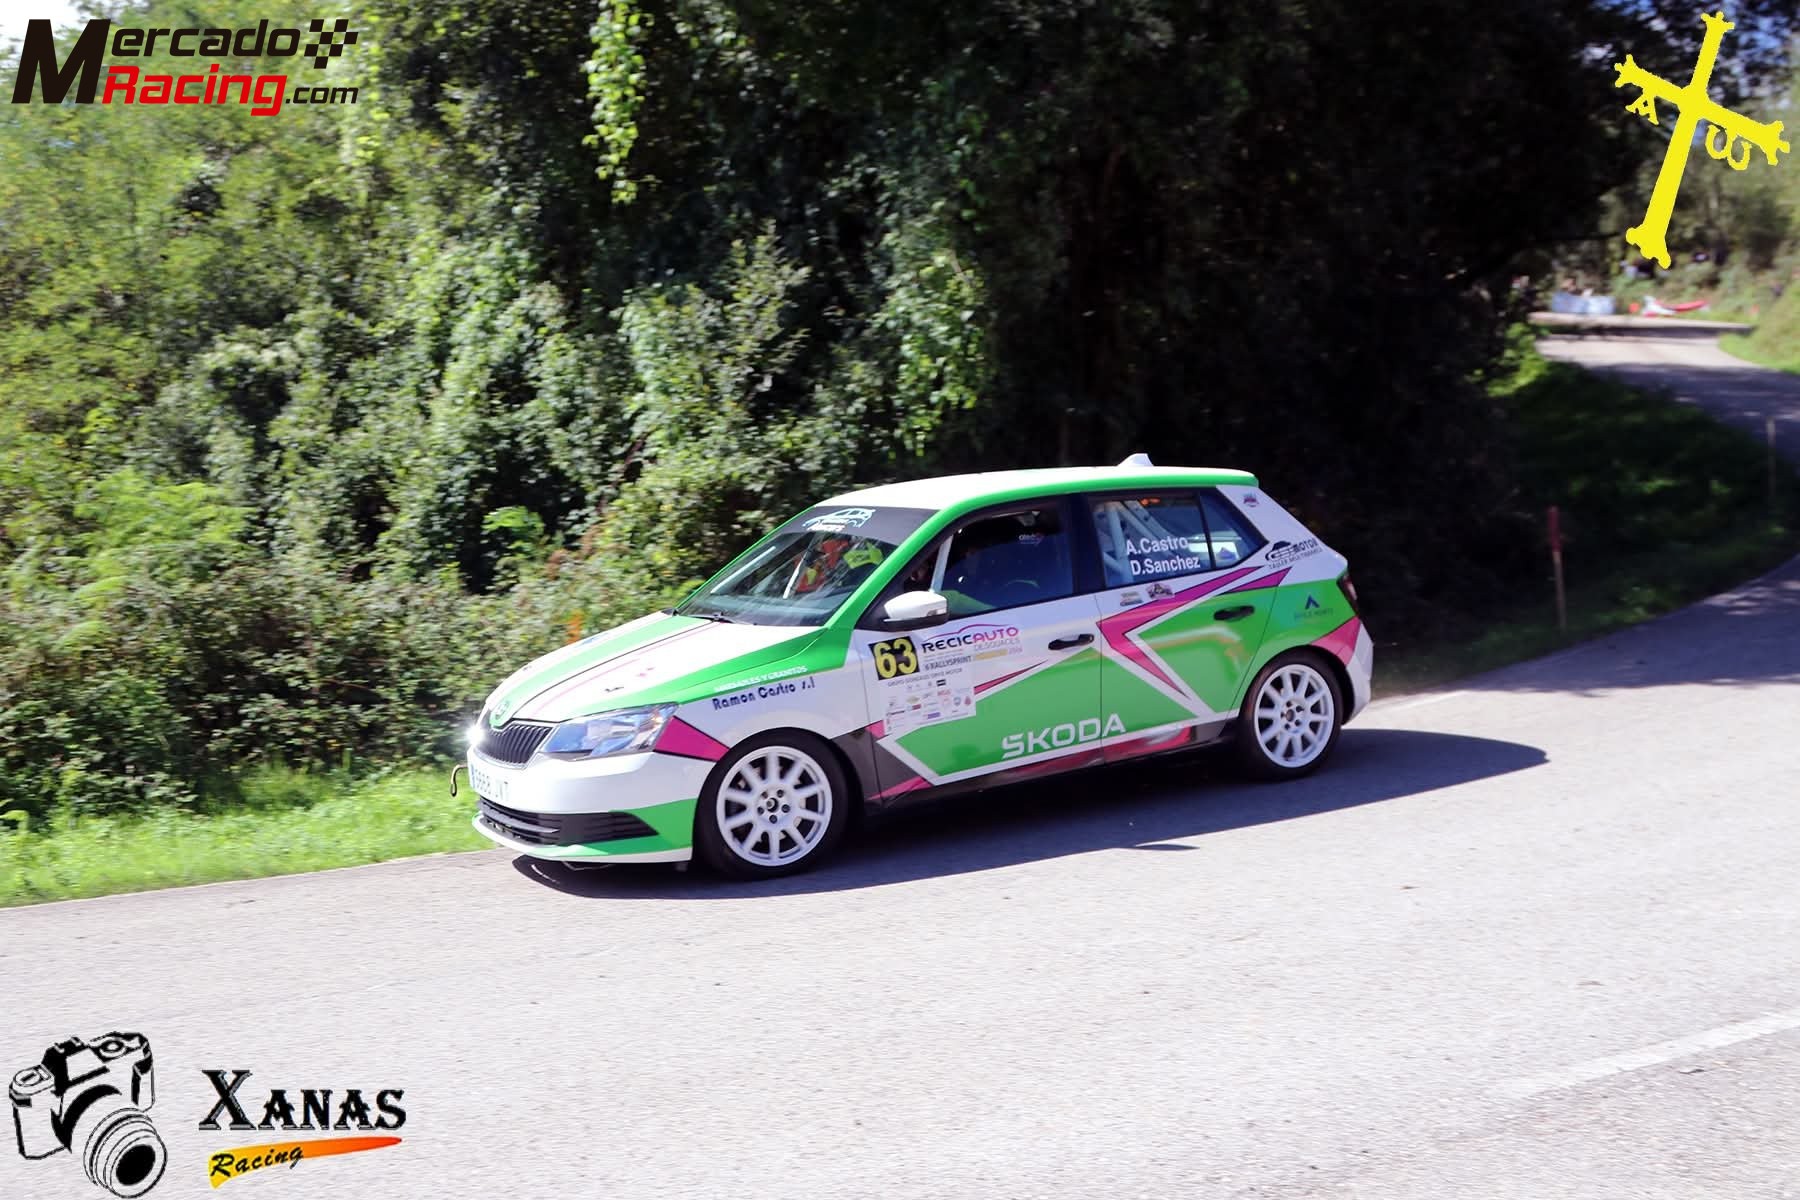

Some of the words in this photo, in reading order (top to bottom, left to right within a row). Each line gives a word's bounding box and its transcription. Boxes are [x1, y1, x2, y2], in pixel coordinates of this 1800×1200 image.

[1127, 536, 1188, 555] A.Castro
[1130, 555, 1201, 575] D.Sanchez
[922, 627, 1019, 653] RECICAUTO
[873, 638, 918, 679] 63
[712, 692, 756, 710] Ramon
[758, 683, 796, 699] Castro
